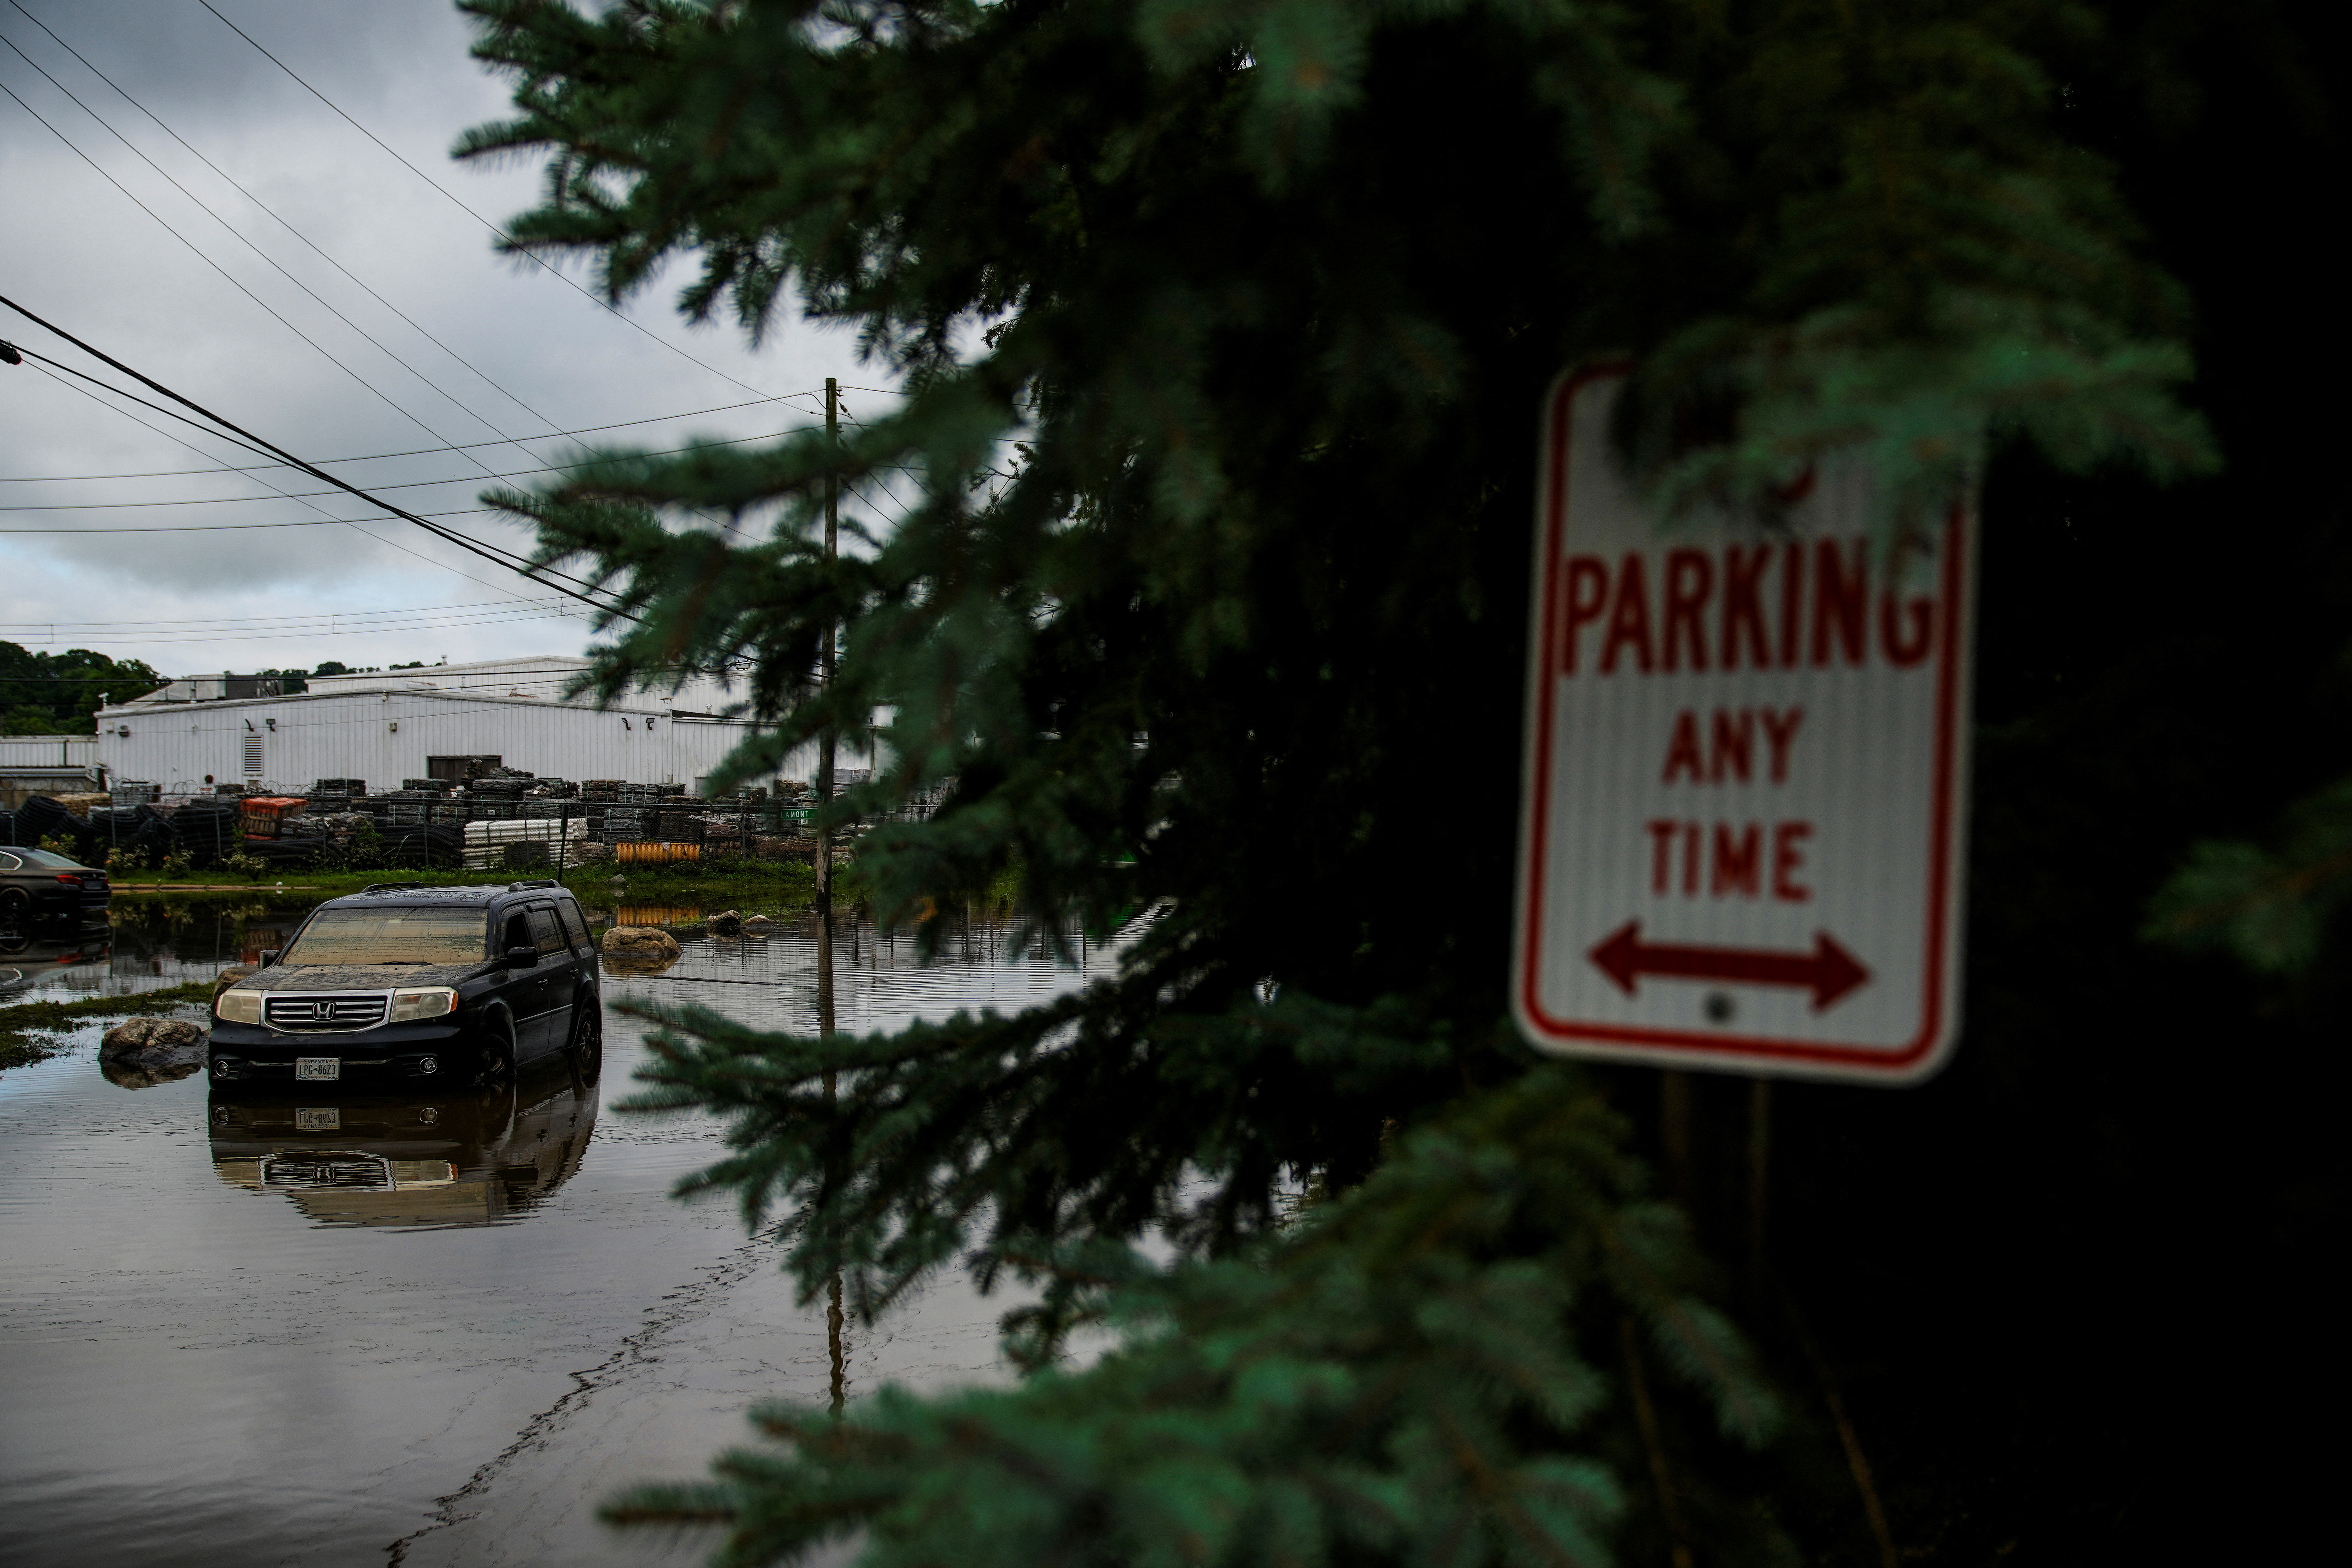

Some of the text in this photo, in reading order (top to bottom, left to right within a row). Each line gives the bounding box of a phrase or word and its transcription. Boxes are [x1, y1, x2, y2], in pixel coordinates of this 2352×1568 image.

[1563, 537, 1933, 675] PARKING
[1662, 704, 1805, 785] ANY
[1646, 820, 1813, 903] TIME
